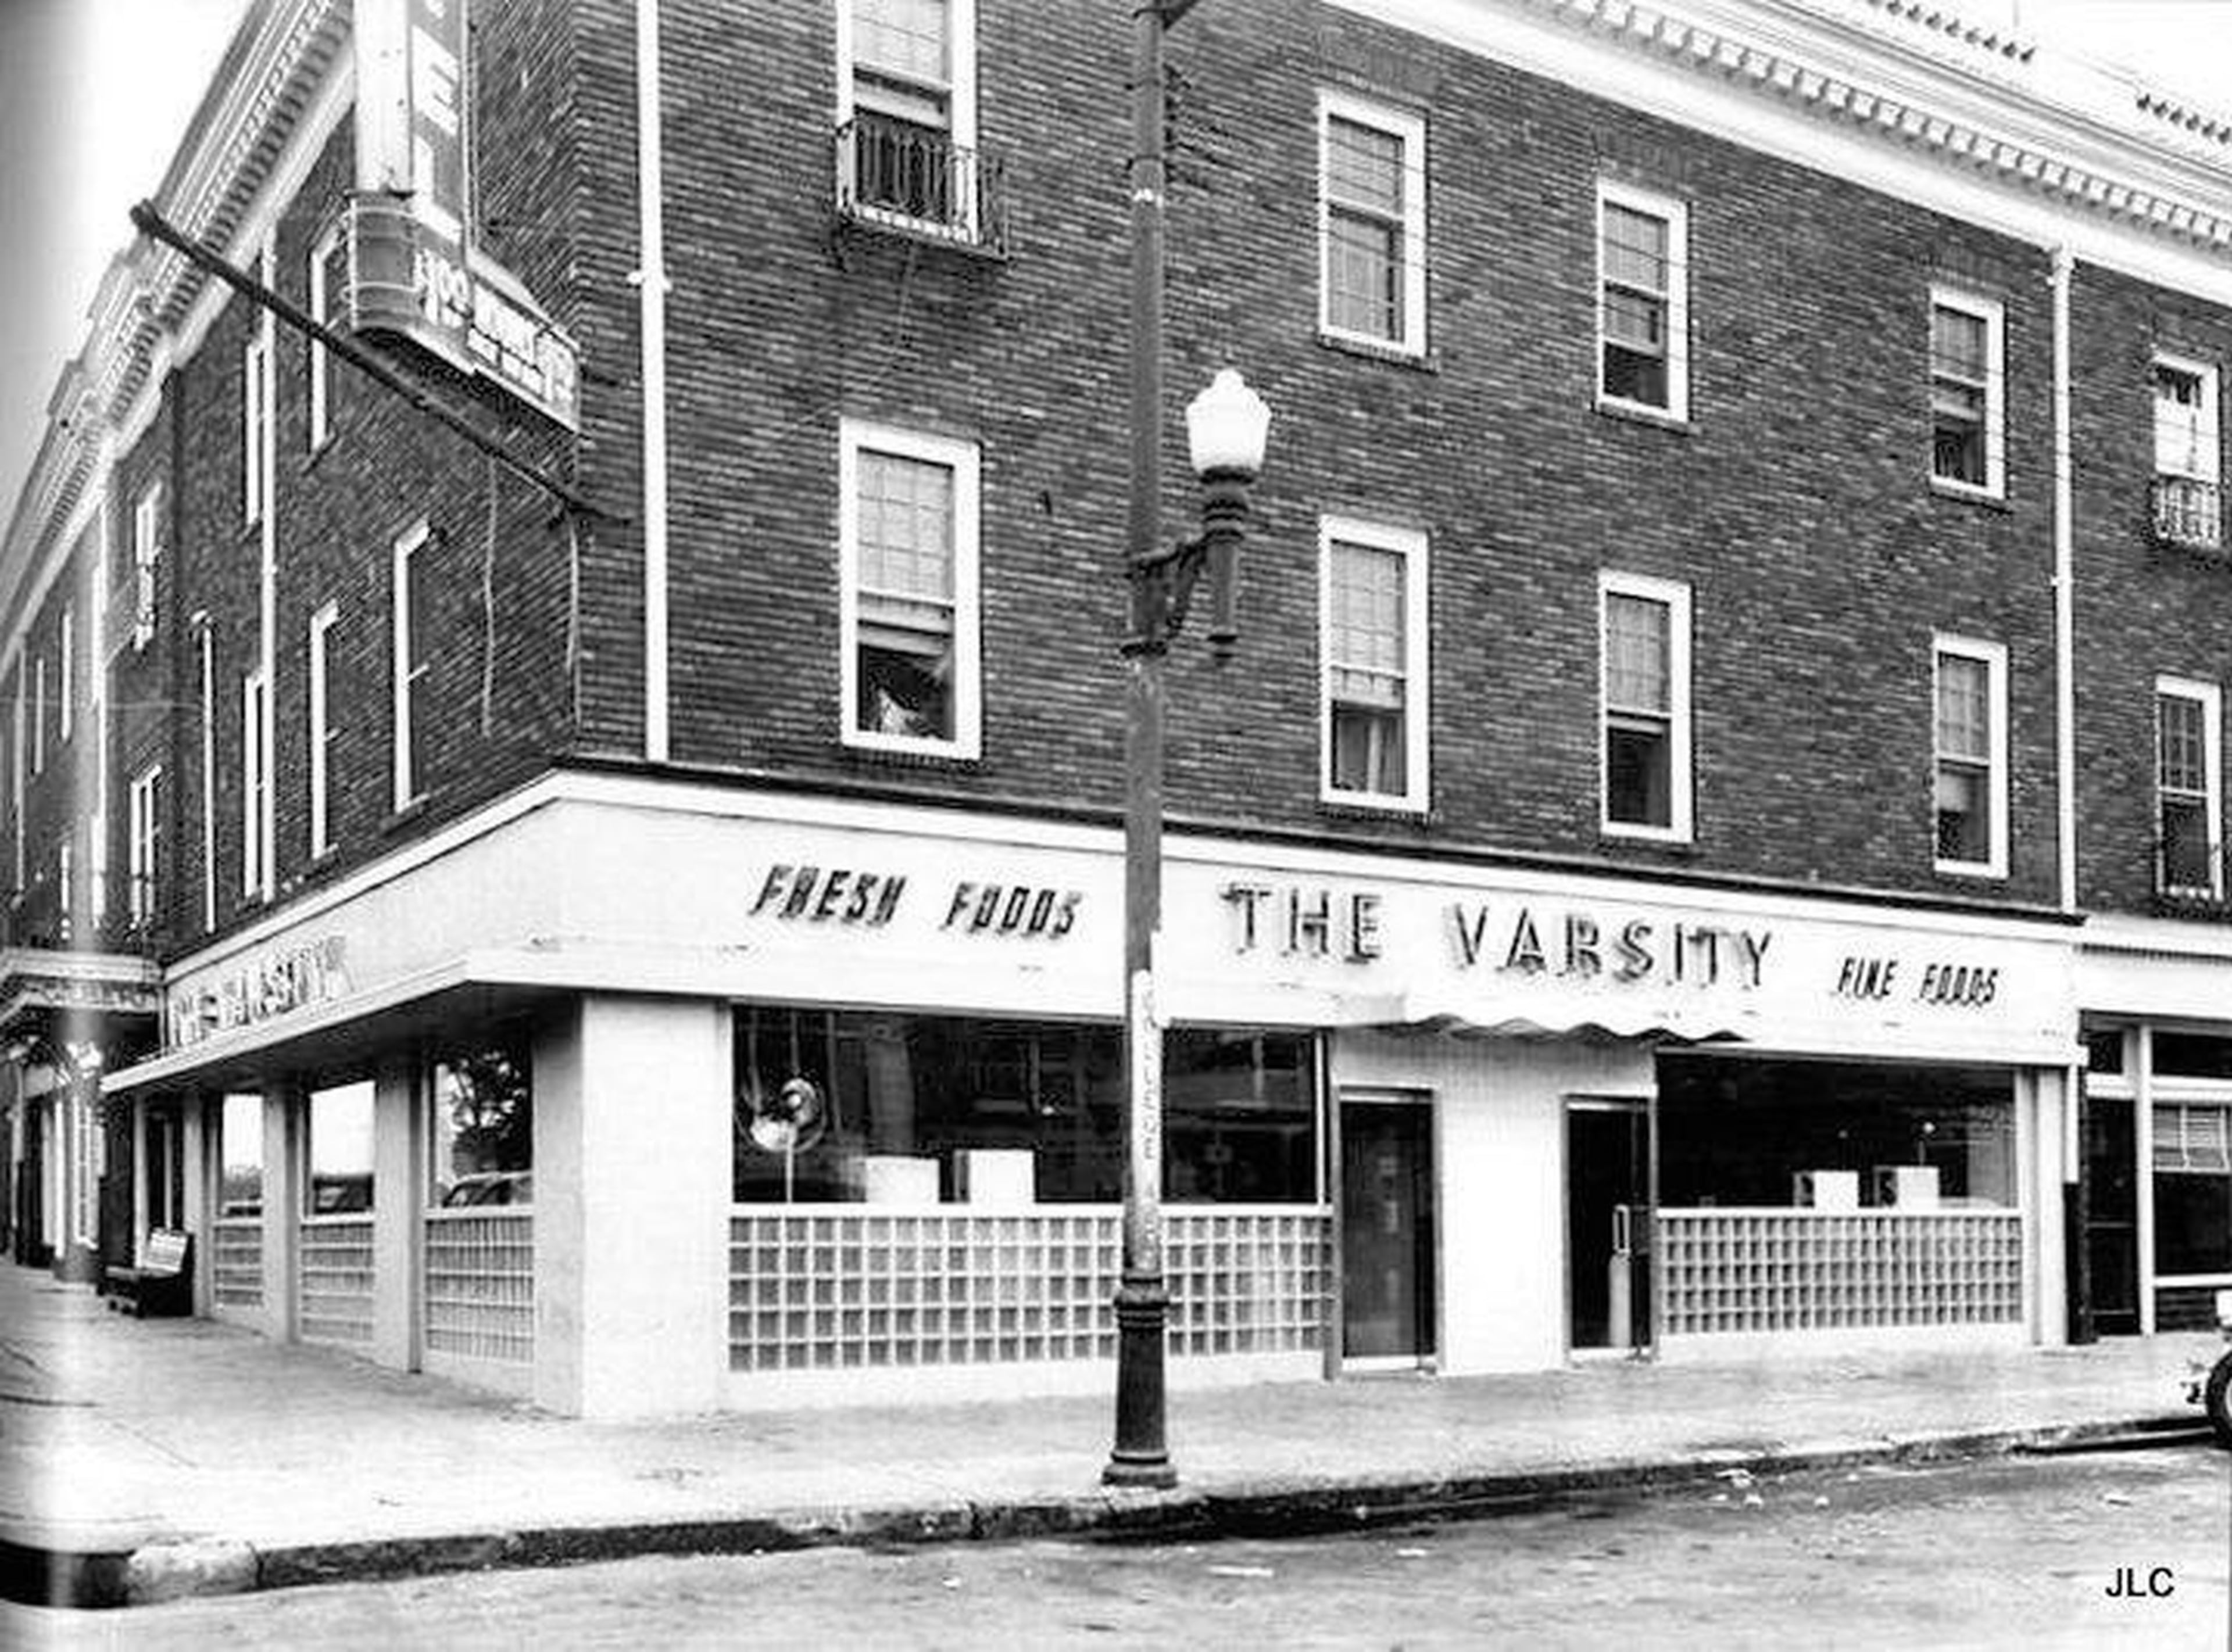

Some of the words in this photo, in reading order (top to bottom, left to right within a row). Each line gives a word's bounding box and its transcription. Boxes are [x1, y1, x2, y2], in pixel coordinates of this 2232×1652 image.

[748, 865, 907, 928] FRESH
[939, 882, 1082, 939] FOODS
[1221, 881, 1381, 965] THE
[1447, 903, 1772, 990] VARSITY
[1831, 956, 1898, 999] FINE
[1913, 962, 1998, 1007] FOODS
